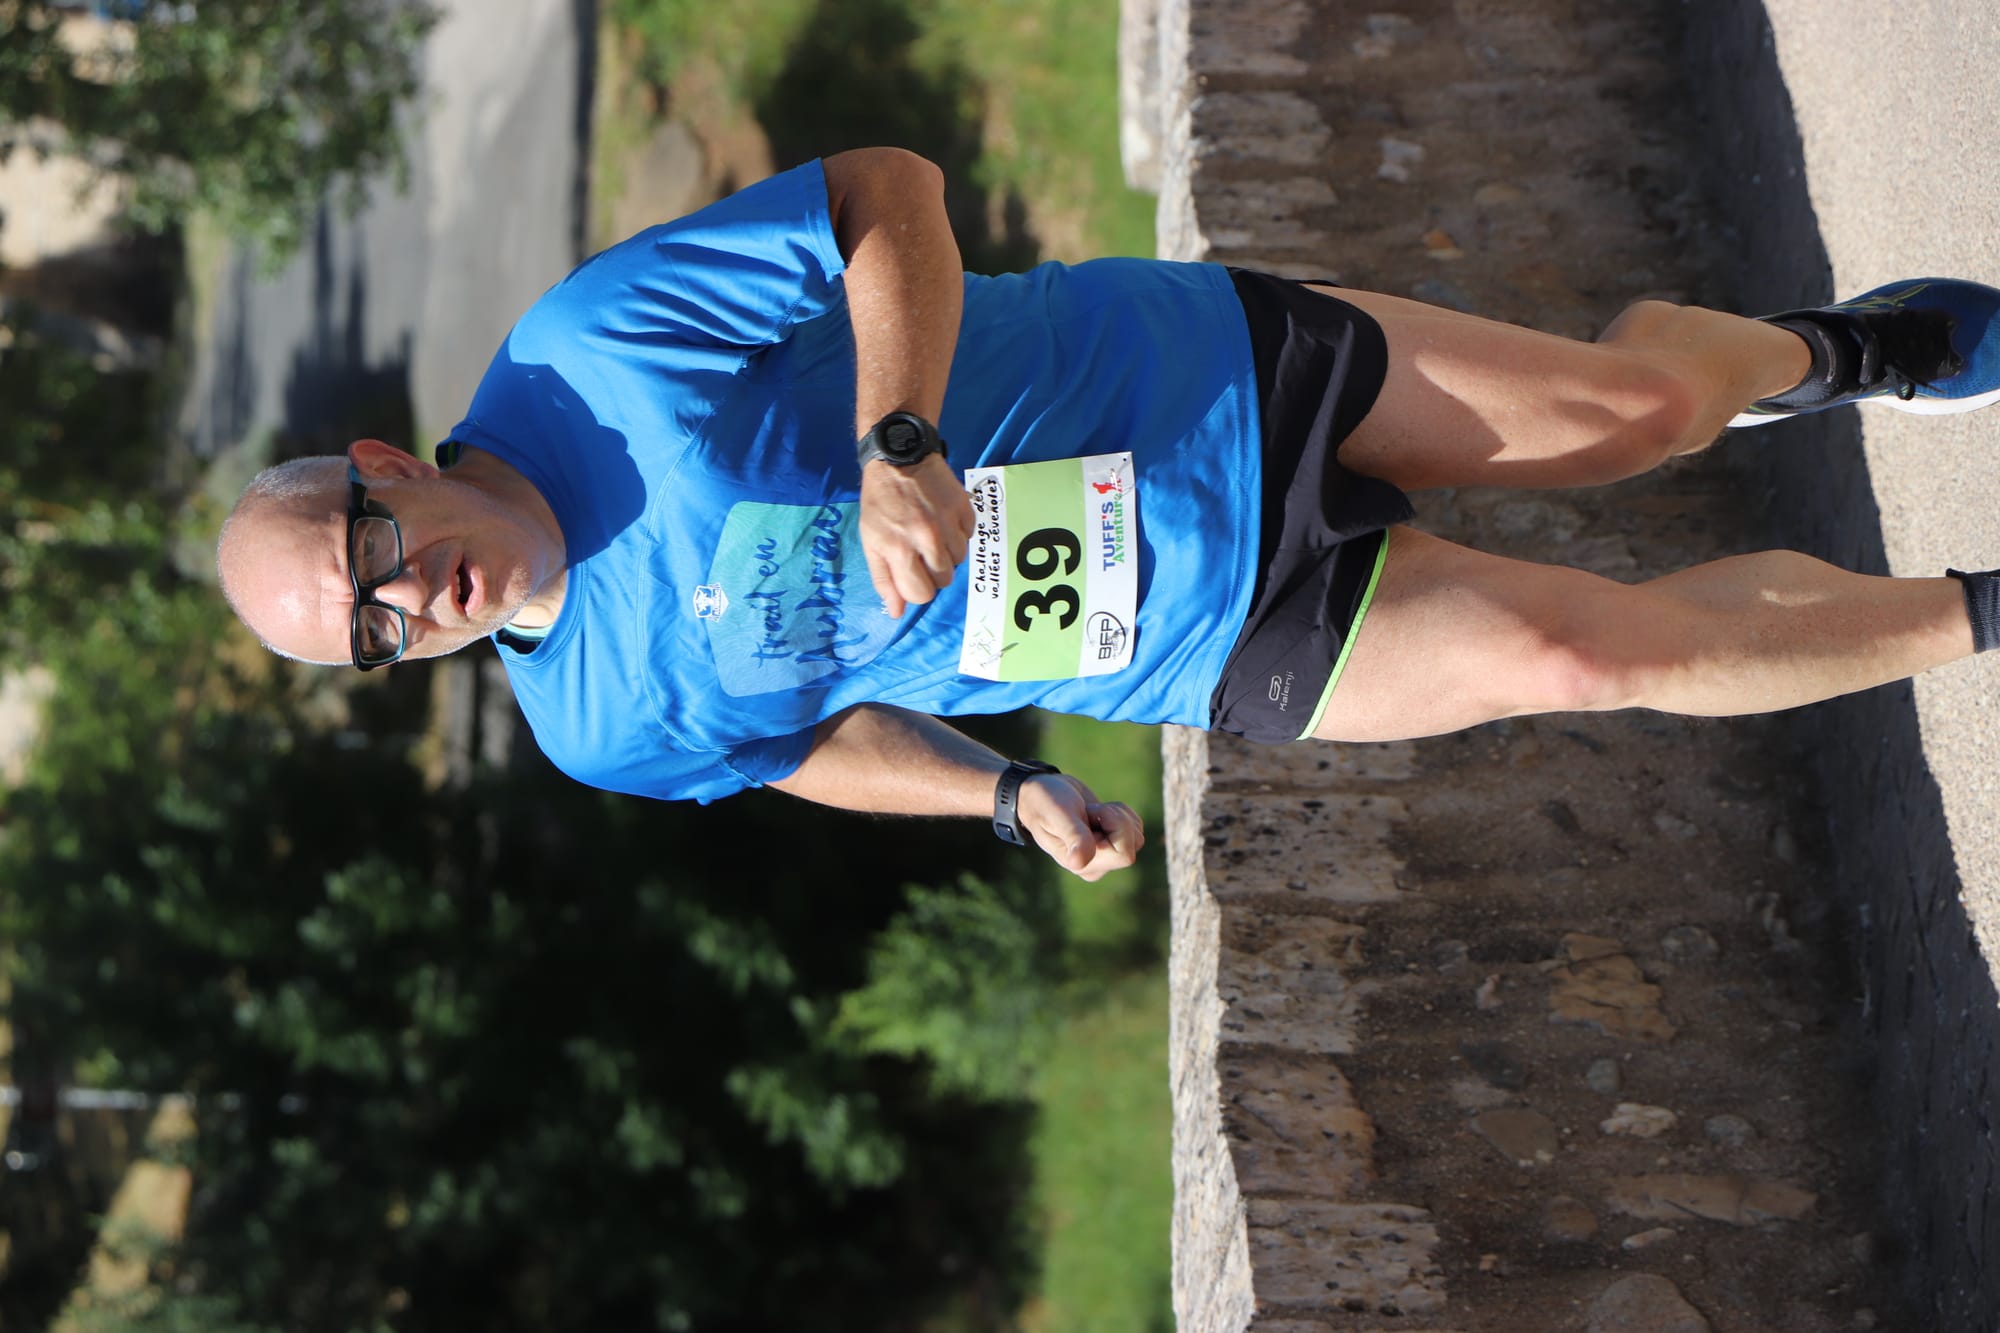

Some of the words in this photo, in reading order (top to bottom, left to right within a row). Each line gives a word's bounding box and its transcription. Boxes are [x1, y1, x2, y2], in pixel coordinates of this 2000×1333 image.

[973, 489, 985, 512] des
[987, 479, 1000, 542] cévenoles
[753, 537, 779, 577] en
[975, 522, 990, 593] Challenge
[1101, 502, 1115, 571] TUFF'S
[795, 505, 868, 664] Aubrac
[989, 552, 1000, 599] vallées
[1014, 528, 1081, 632] 39
[743, 591, 793, 668] trail
[1098, 619, 1112, 659] BFP
[1279, 671, 1295, 711] Kalenji
